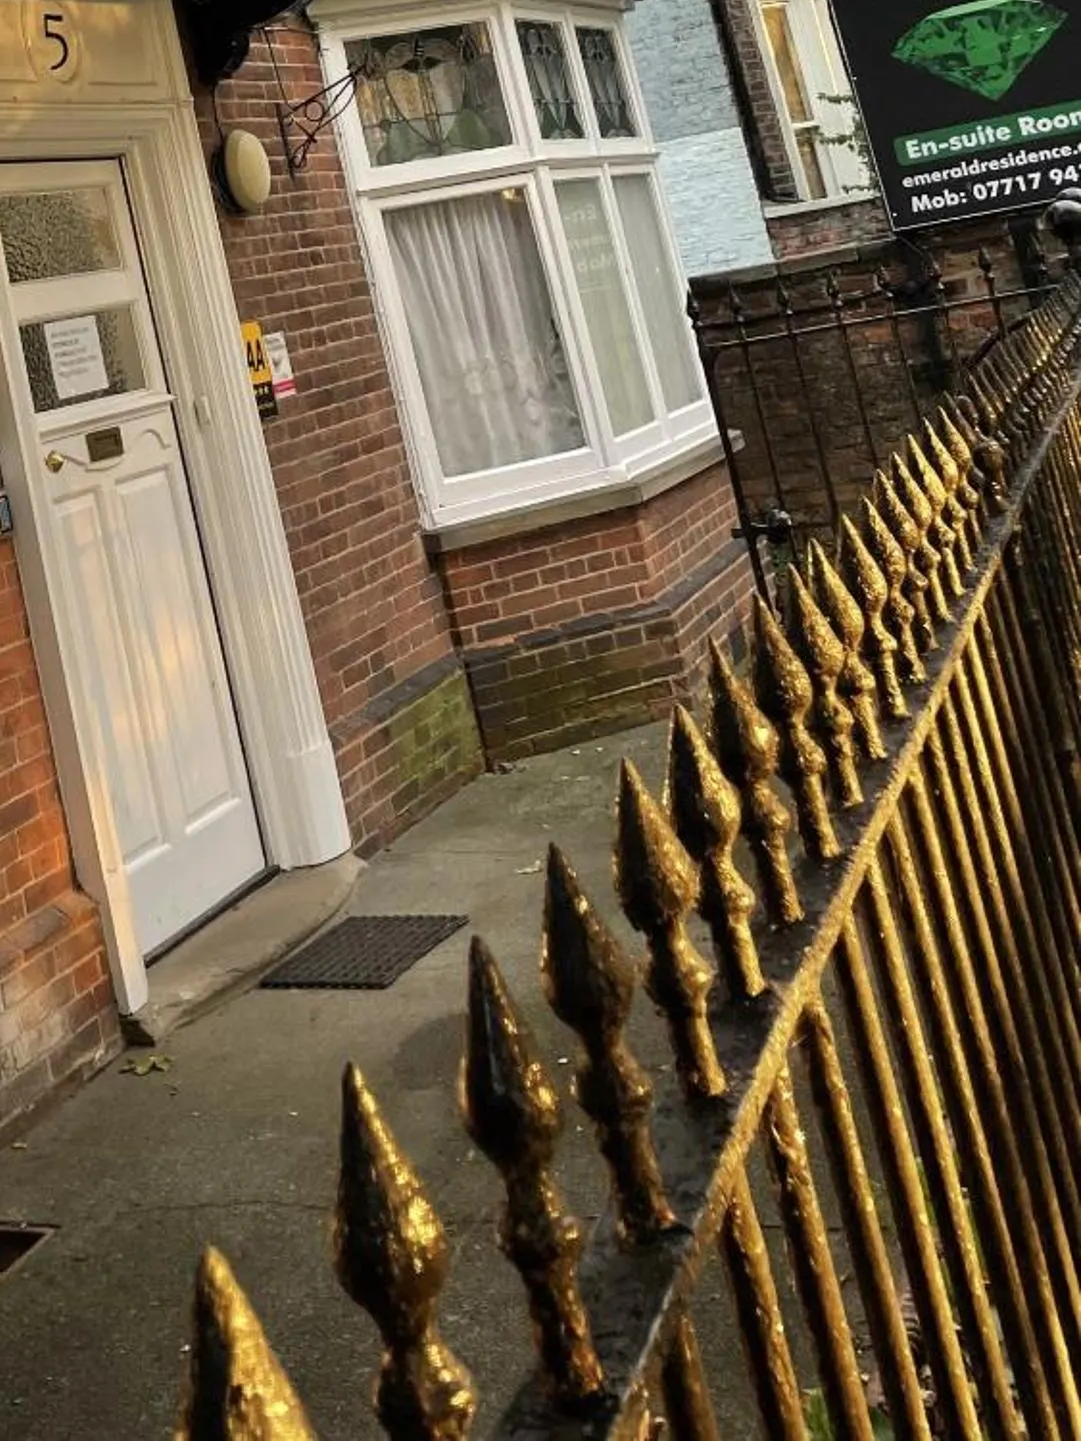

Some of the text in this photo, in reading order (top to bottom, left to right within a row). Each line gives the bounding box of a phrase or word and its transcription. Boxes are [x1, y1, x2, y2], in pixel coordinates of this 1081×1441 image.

[43, 14, 69, 70] 5
[905, 124, 1012, 159] En-suite
[902, 142, 1081, 188] emeraldresidence.
[911, 163, 1081, 213] Mob: 07717 94
[247, 339, 265, 371] AA
